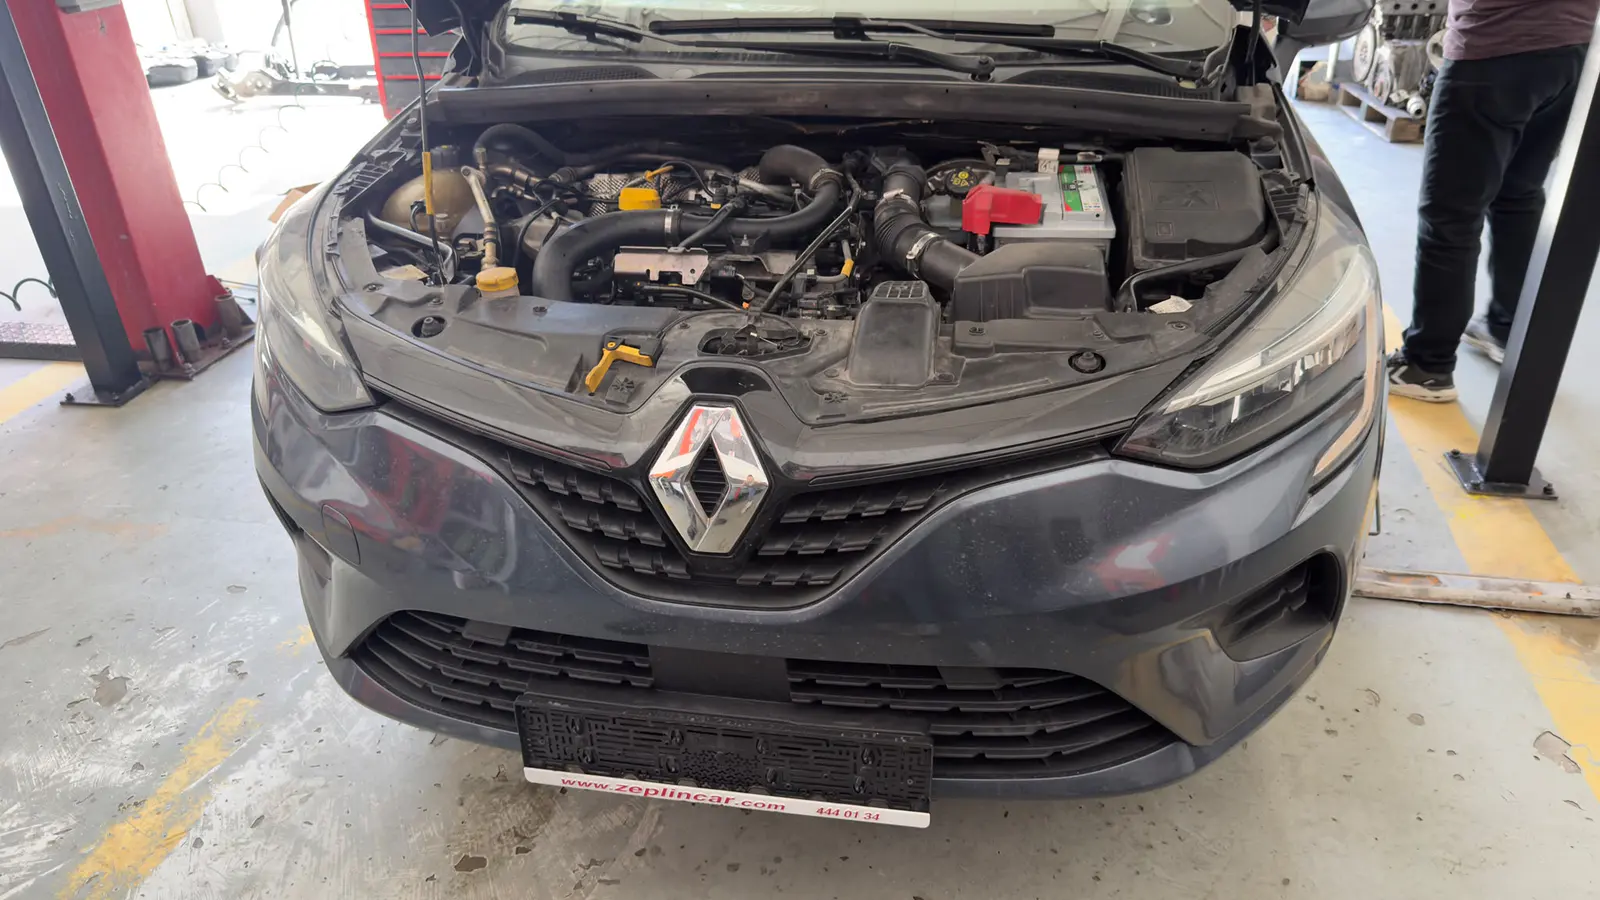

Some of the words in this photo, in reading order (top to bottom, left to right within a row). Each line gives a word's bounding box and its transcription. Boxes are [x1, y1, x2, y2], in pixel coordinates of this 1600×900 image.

[561, 778, 785, 811] www.zeplincar.com
[816, 807, 840, 816] 444
[843, 810, 859, 819] 01
[863, 812, 880, 821] 34
